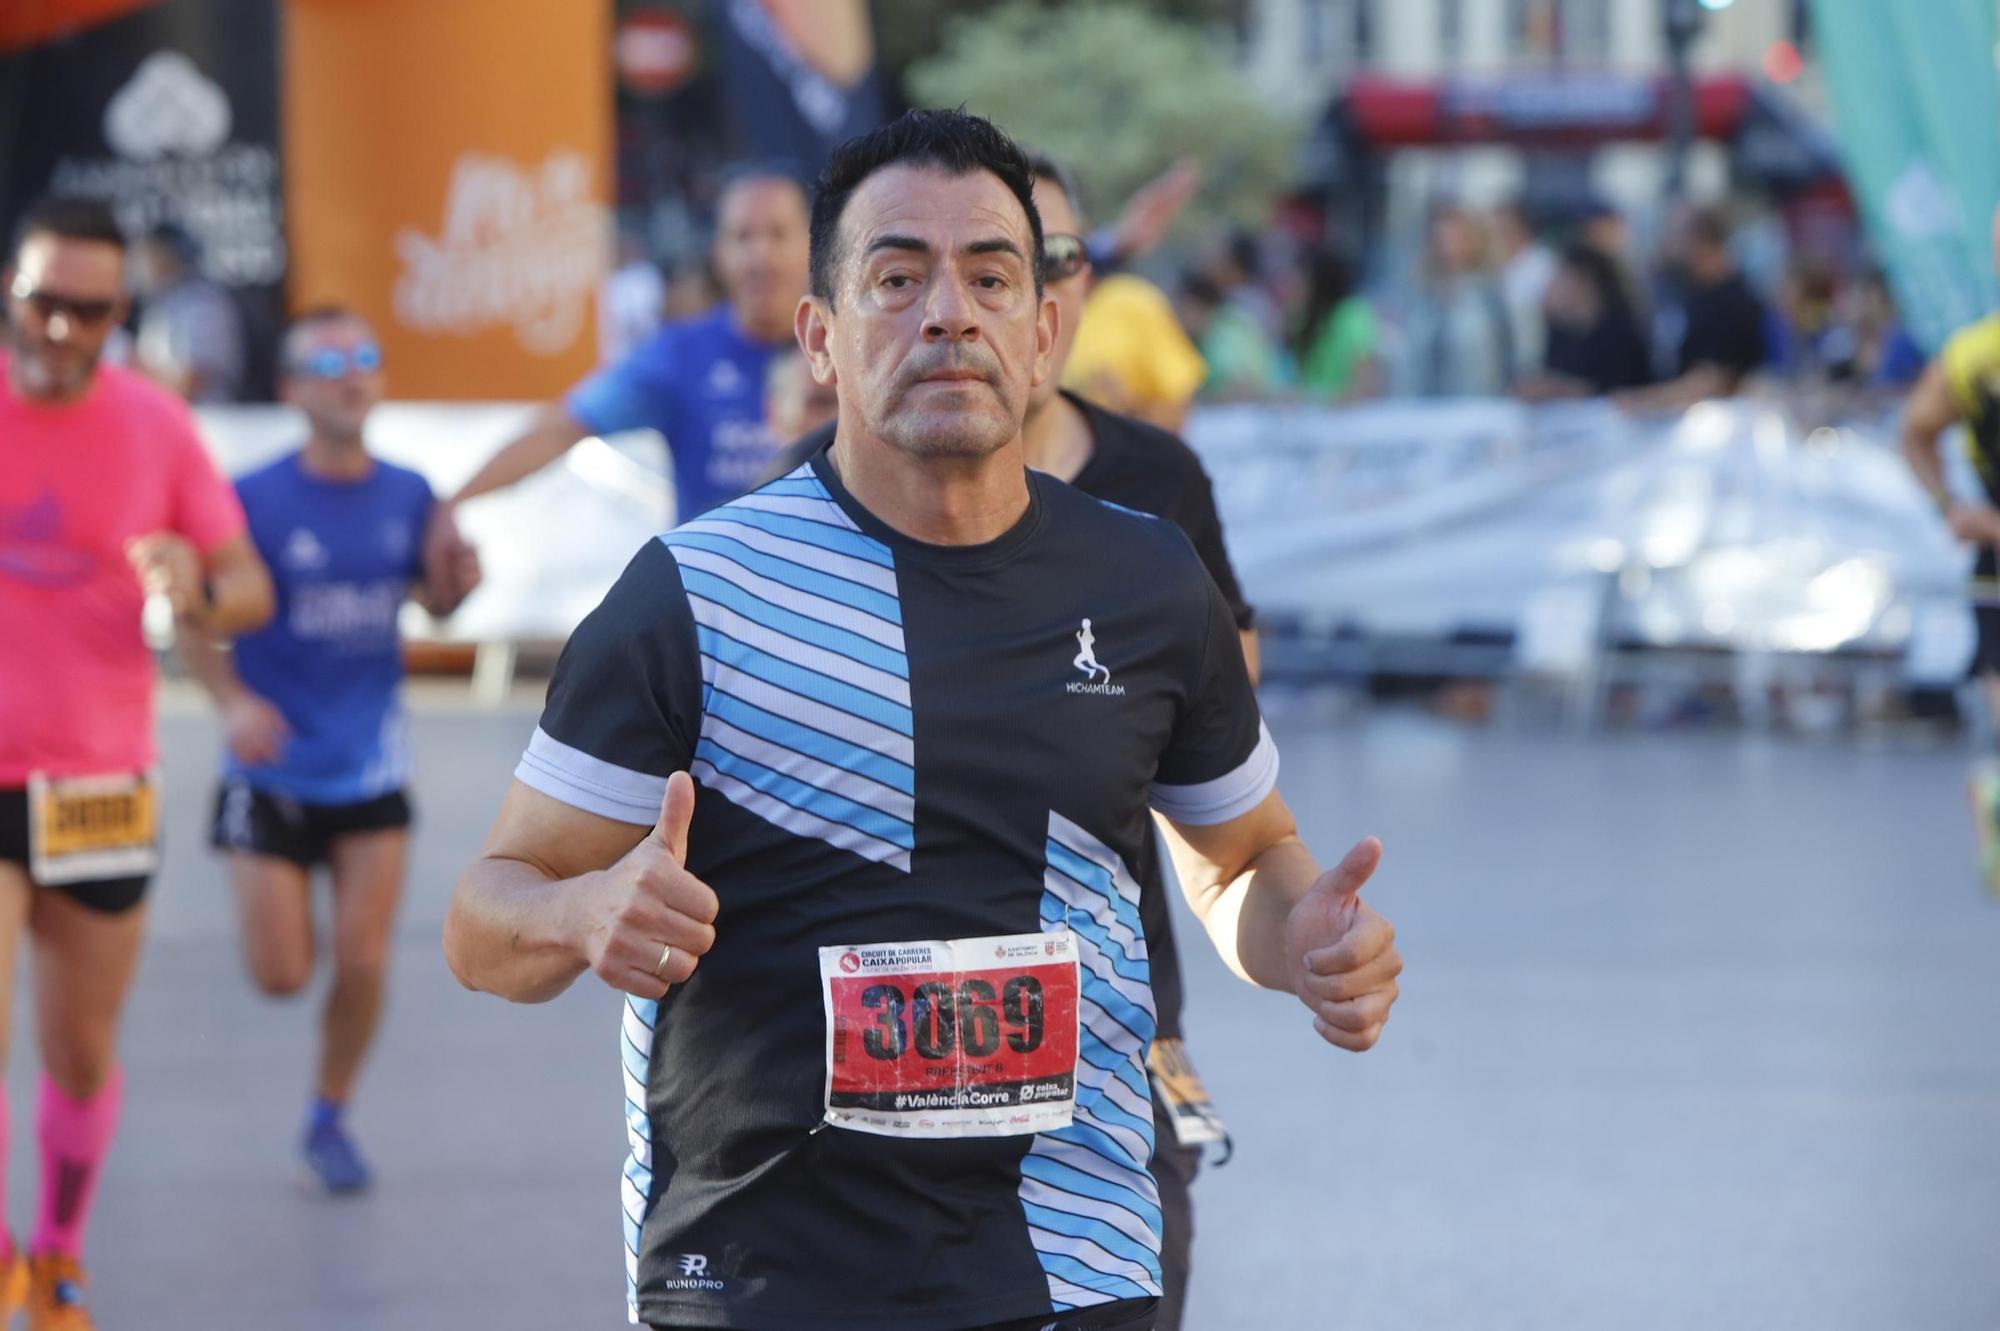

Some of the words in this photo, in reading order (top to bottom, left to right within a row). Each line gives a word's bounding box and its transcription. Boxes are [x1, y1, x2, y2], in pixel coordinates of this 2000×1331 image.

[1066, 682, 1126, 695] HICHAMTEAM
[861, 950, 887, 958] CIRCUIT
[898, 947, 931, 956] CARRERES
[862, 955, 932, 967] CAIXAPOPULAR
[861, 976, 1045, 1060] 3069
[895, 1090, 1009, 1109] #ValènciaCorre
